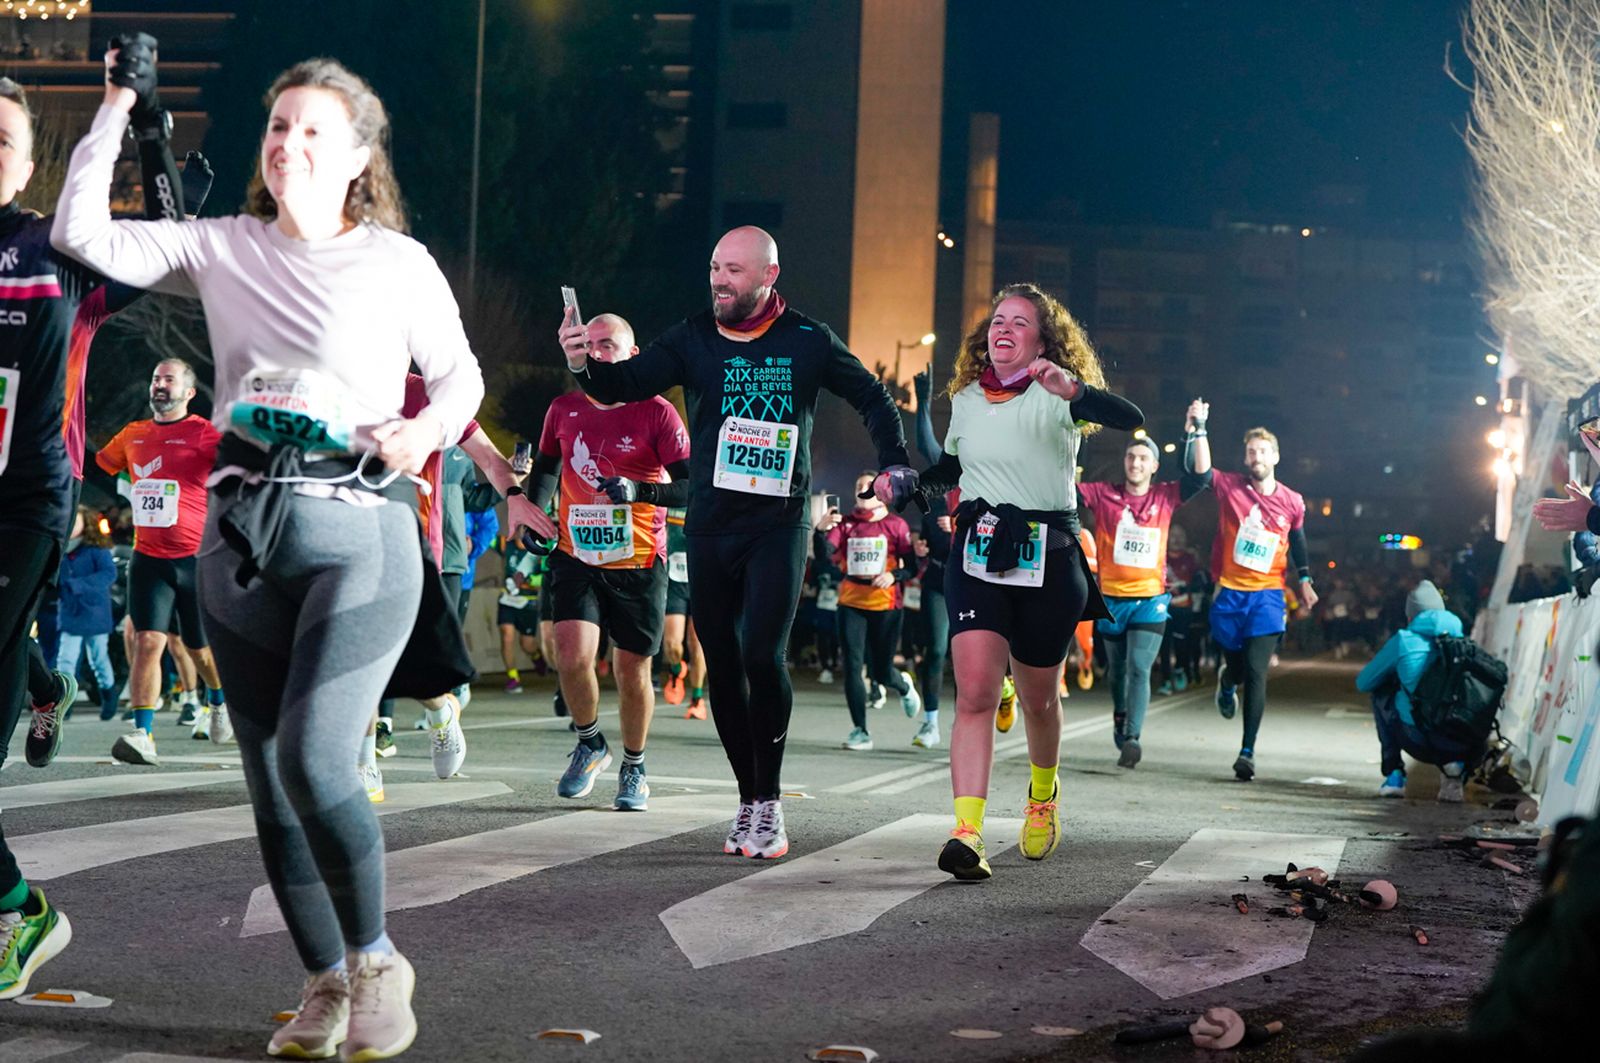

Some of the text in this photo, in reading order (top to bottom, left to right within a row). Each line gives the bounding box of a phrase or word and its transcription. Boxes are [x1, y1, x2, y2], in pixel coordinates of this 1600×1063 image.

[724, 368, 752, 382] XIX
[724, 382, 792, 392] DÍA DE REYES
[727, 433, 743, 443] SAN
[737, 427, 772, 438] NOCHE DE
[727, 443, 786, 471] 12565
[581, 464, 597, 481] 43
[142, 496, 164, 510] 234
[575, 527, 625, 544] 12054
[1123, 541, 1150, 553] 4923
[1243, 540, 1267, 557] 7863
[853, 552, 880, 562] 3602
